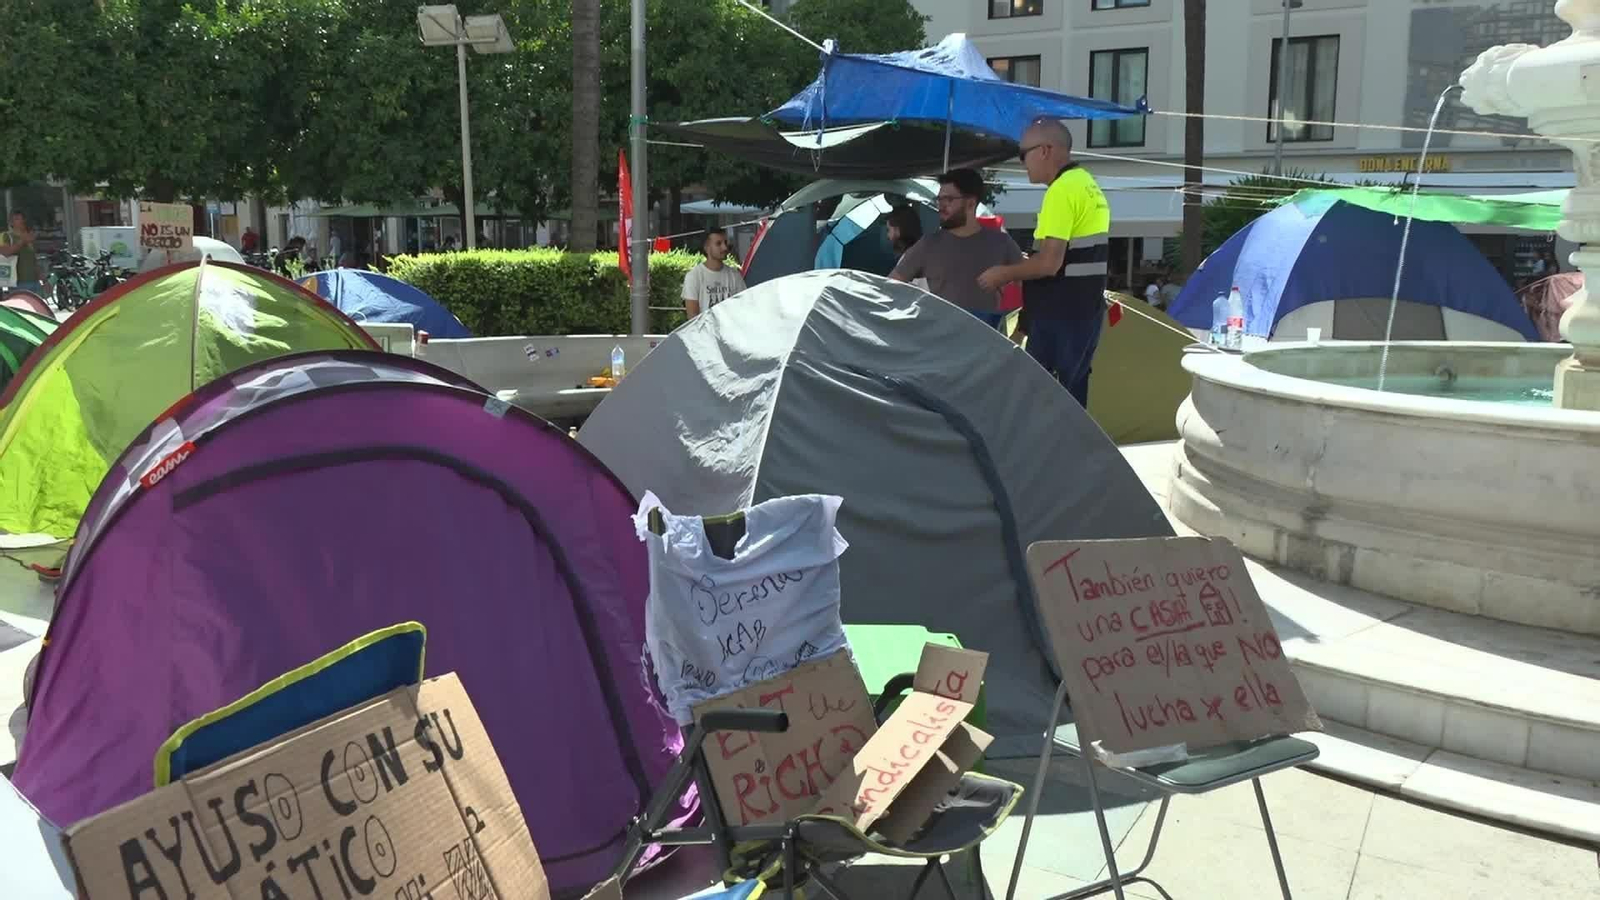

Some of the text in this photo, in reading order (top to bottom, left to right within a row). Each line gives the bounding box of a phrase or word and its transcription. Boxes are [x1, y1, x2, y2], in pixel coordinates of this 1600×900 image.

[141, 223, 158, 236] NO
[175, 226, 190, 236] UN
[1044, 548, 1230, 603] También quiero
[1077, 612, 1122, 642] una
[1082, 647, 1136, 692] para
[1197, 640, 1227, 673] que
[1237, 631, 1281, 665] NO
[808, 692, 856, 720] the
[1114, 691, 1198, 737] lucha
[1234, 673, 1282, 711] ella
[119, 709, 464, 900] AYUSO CON SU
